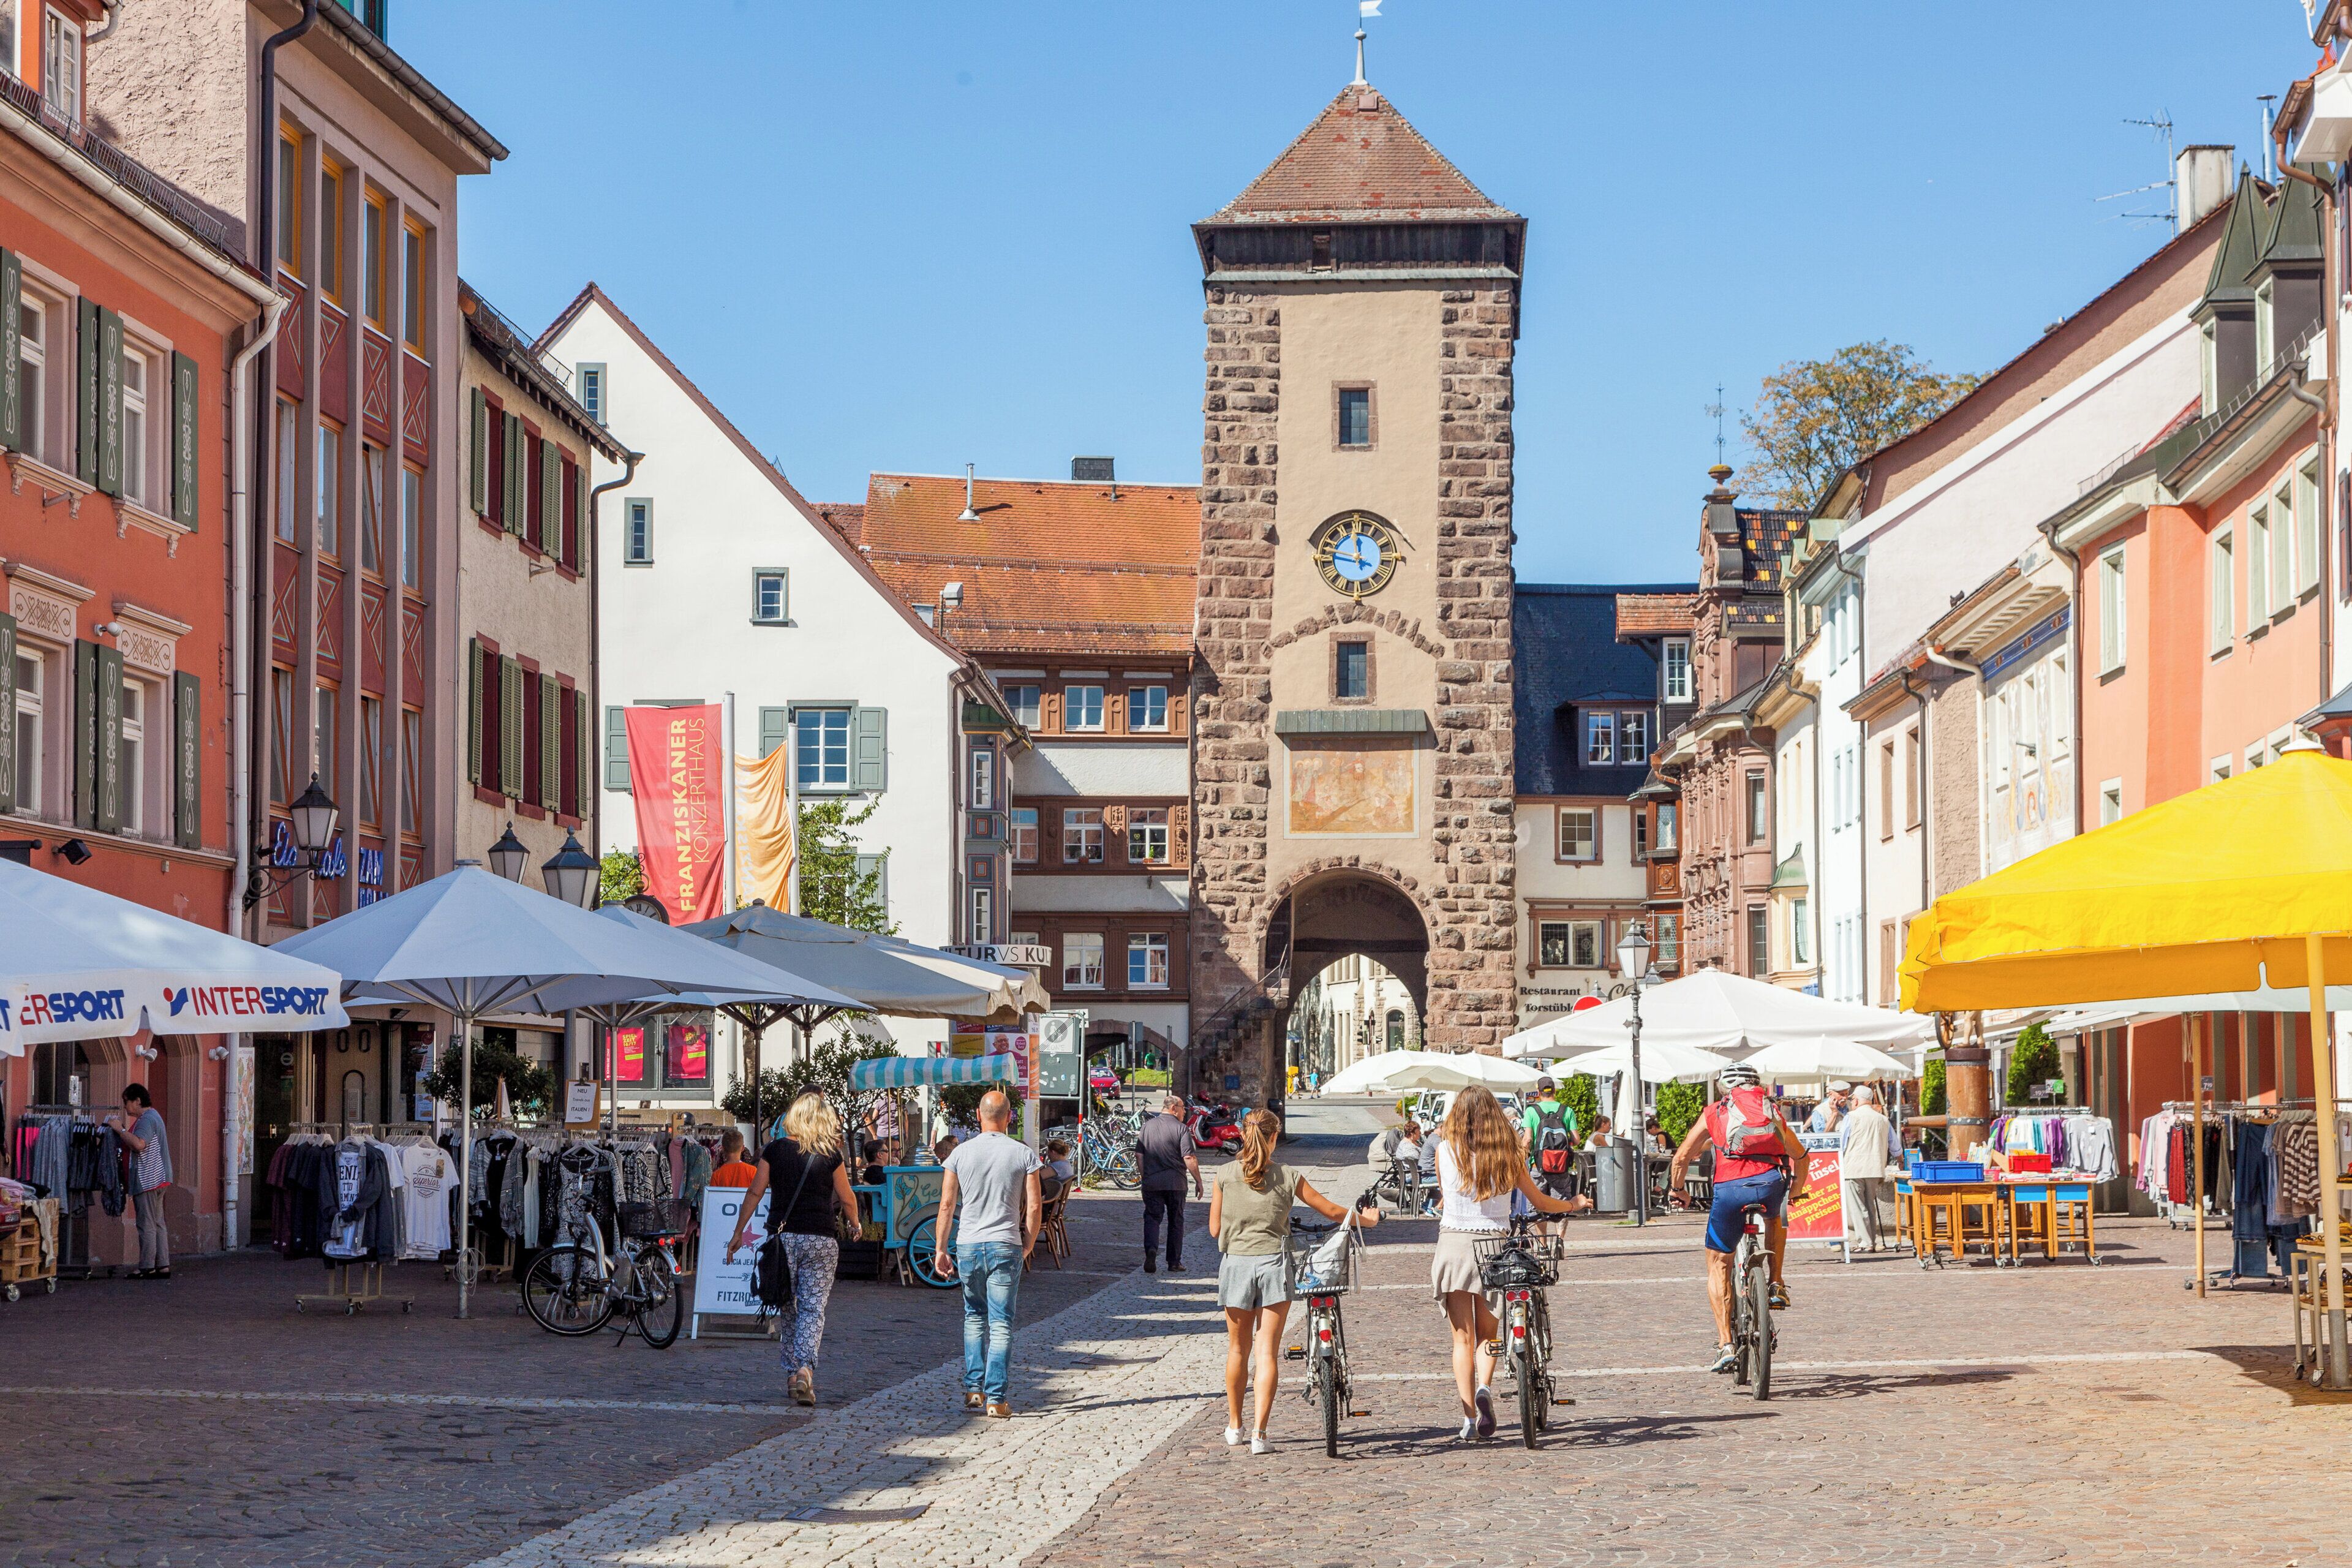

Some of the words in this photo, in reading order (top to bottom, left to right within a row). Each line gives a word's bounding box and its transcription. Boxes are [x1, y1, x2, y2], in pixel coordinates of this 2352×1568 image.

[688, 718, 710, 863] KONZERTHAUS
[671, 719, 696, 911] FRANZISKANER
[191, 986, 329, 1016] INTERSPORT
[1520, 987, 1581, 996] Restaurant
[1809, 1159, 1840, 1182] Insel
[1826, 1182, 1839, 1193] zu
[722, 1203, 770, 1218] OL
[1804, 1202, 1842, 1226] preisen!
